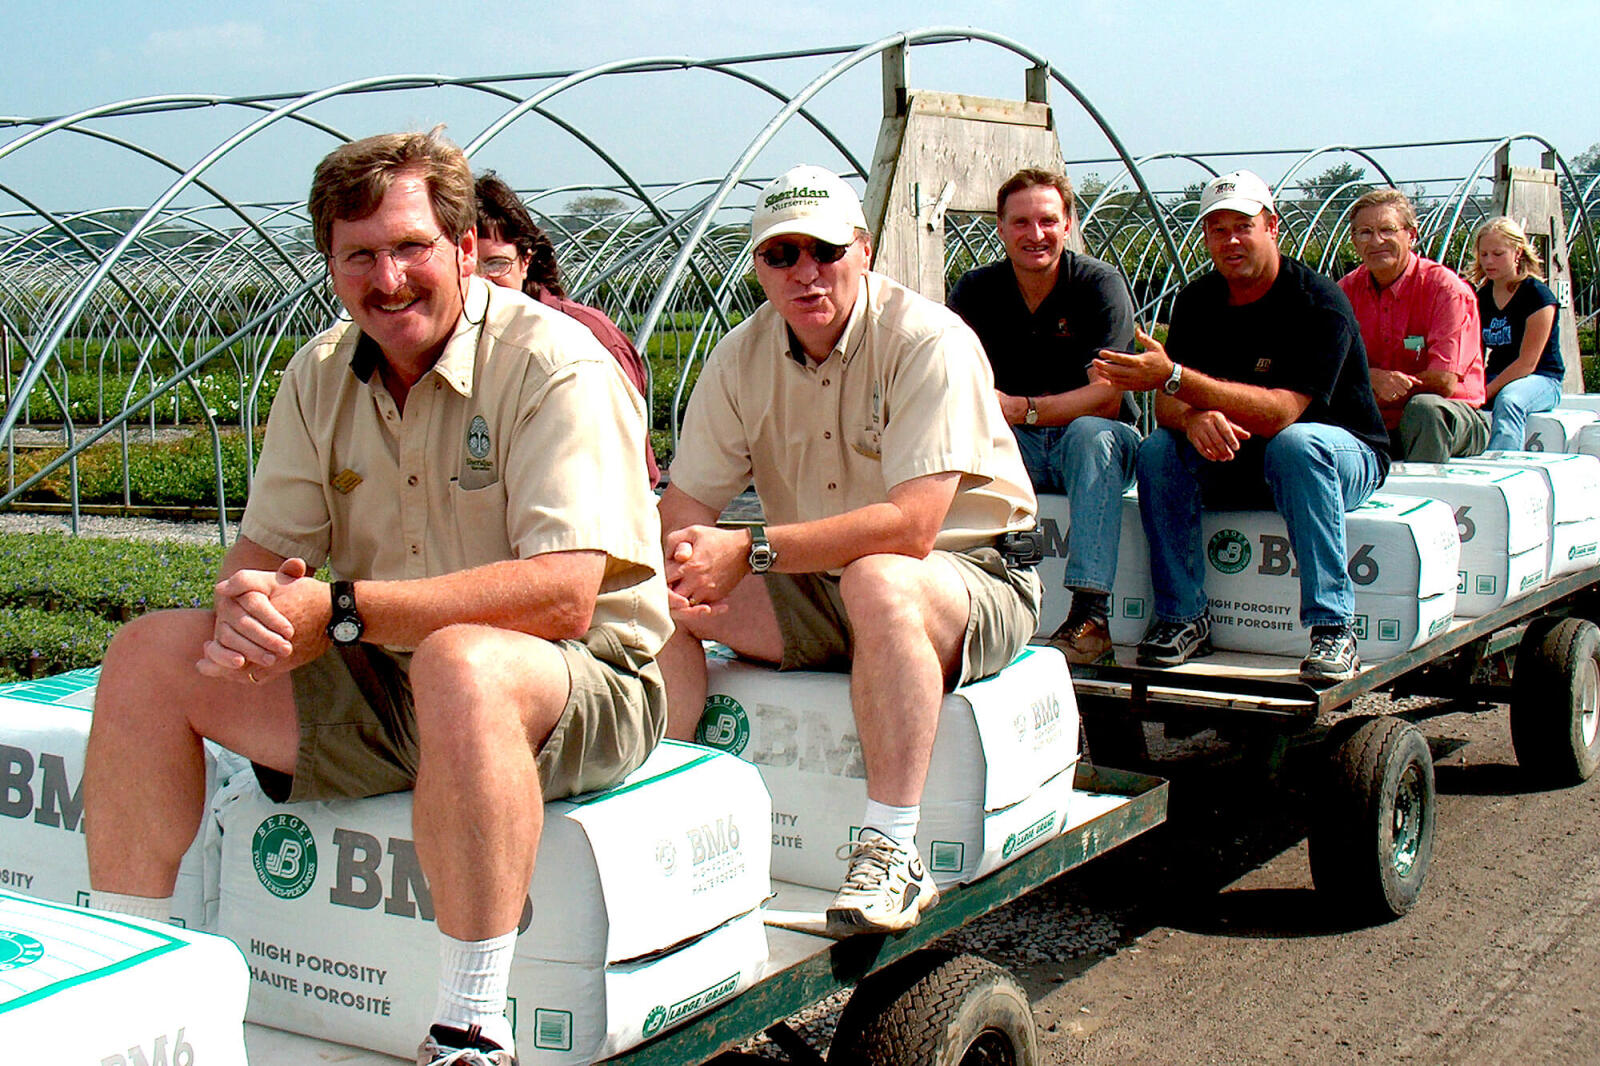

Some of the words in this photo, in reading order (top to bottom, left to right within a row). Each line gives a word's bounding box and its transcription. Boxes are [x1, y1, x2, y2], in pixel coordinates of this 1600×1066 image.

[764, 187, 829, 208] Sheridan
[1209, 614, 1234, 625] AUTE
[1234, 602, 1291, 615] POROSITY
[257, 815, 313, 848] BERGER
[686, 814, 740, 866] BM6
[0, 868, 34, 889] SITY
[250, 938, 292, 965] HIGH
[296, 952, 387, 985] POROSITY
[248, 965, 298, 993] HAUTE
[303, 982, 391, 1016] POROSITÉ
